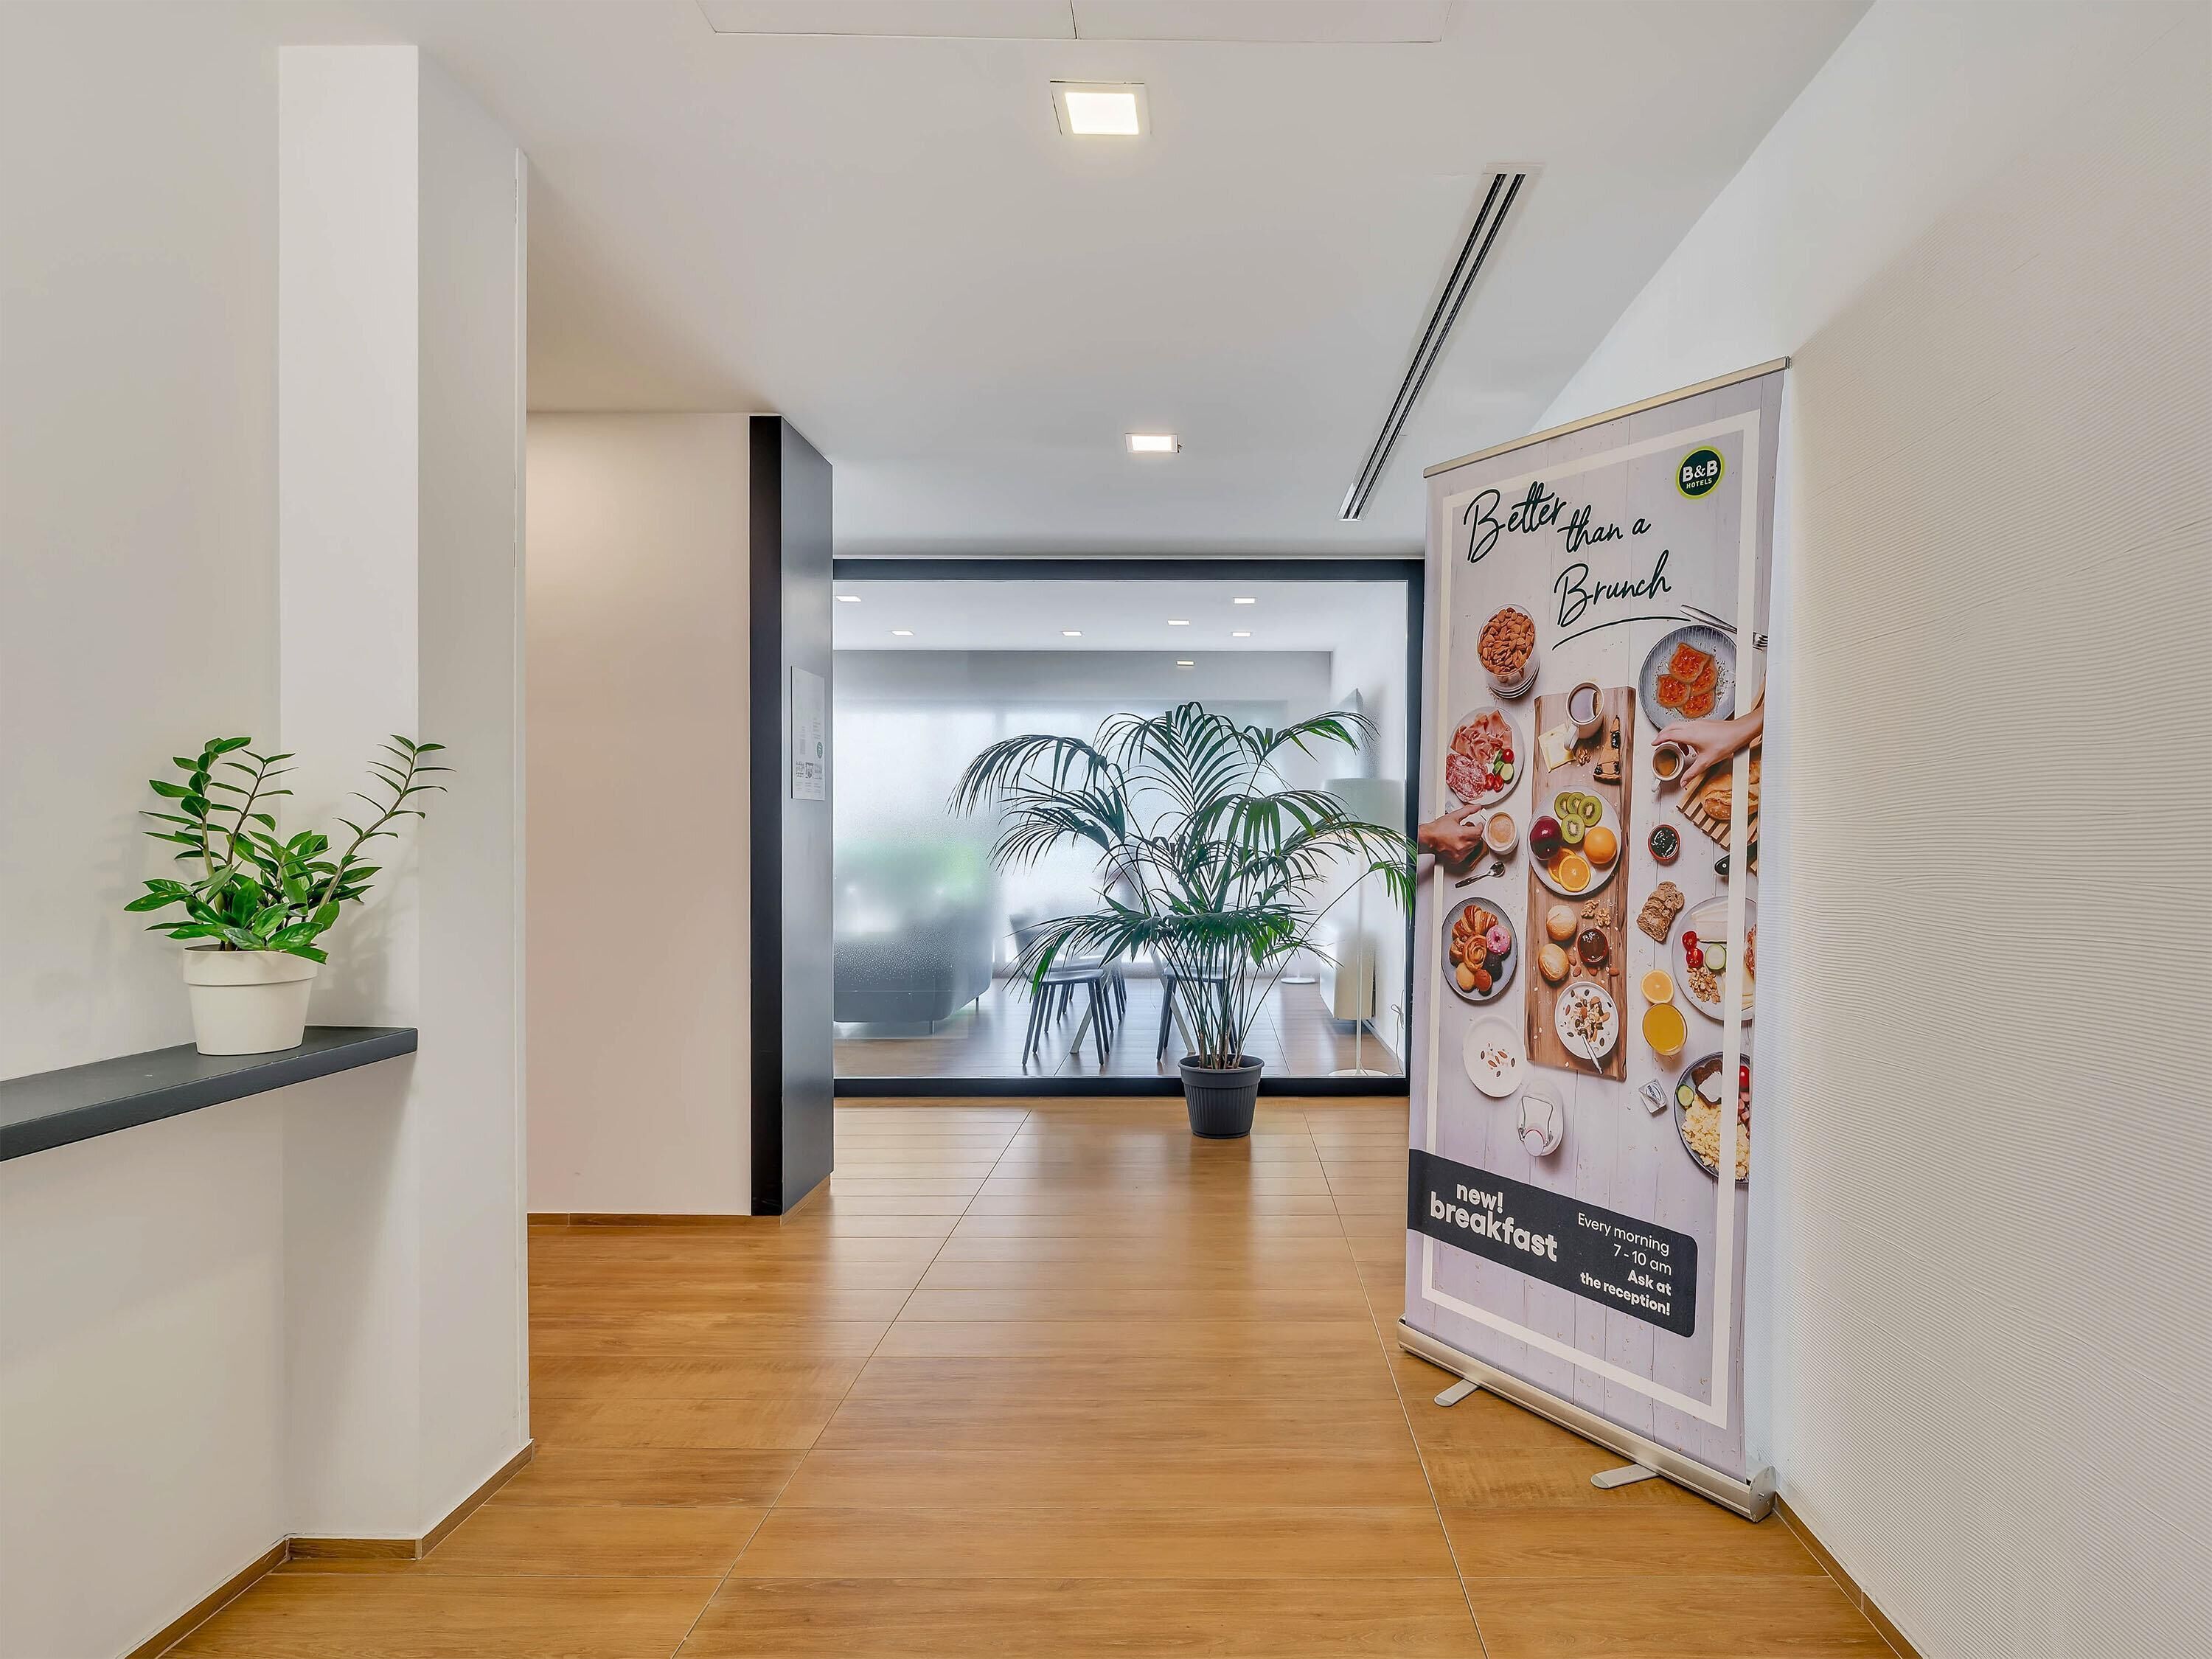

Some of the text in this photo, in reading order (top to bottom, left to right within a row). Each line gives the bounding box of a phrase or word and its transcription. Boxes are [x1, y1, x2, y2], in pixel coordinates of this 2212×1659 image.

[1683, 460, 1718, 482] B&B
[1686, 477, 1712, 489] HOTELS
[1463, 481, 1568, 563] Better
[1557, 504, 1652, 554] than a
[1554, 549, 1672, 627] Brunch
[1455, 1183, 1503, 1214] new!
[1430, 1191, 1558, 1262] breakfast
[1578, 1212, 1670, 1256] Every morning
[1613, 1244, 1621, 1257] 7
[1632, 1251, 1646, 1267] 10
[1650, 1259, 1672, 1276] am
[1580, 1271, 1671, 1316] the reception!
[1627, 1270, 1672, 1297] Ask at
